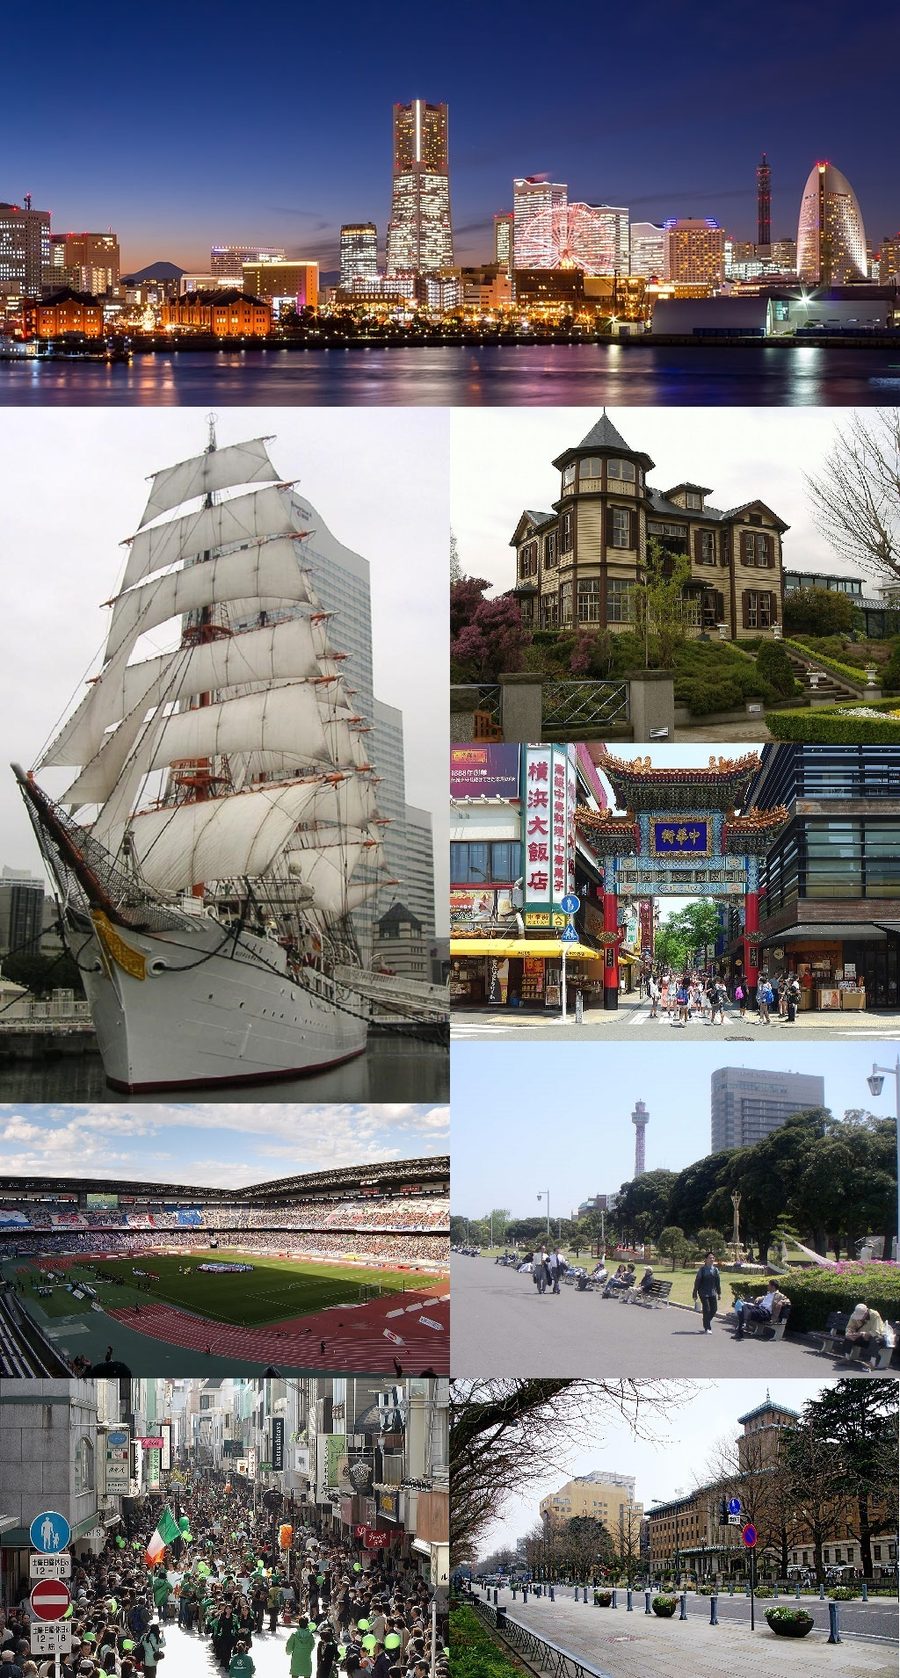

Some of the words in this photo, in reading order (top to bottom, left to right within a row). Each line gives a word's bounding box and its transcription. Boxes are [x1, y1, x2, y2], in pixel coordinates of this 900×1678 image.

[527, 761, 549, 891] 横浜大飯店
